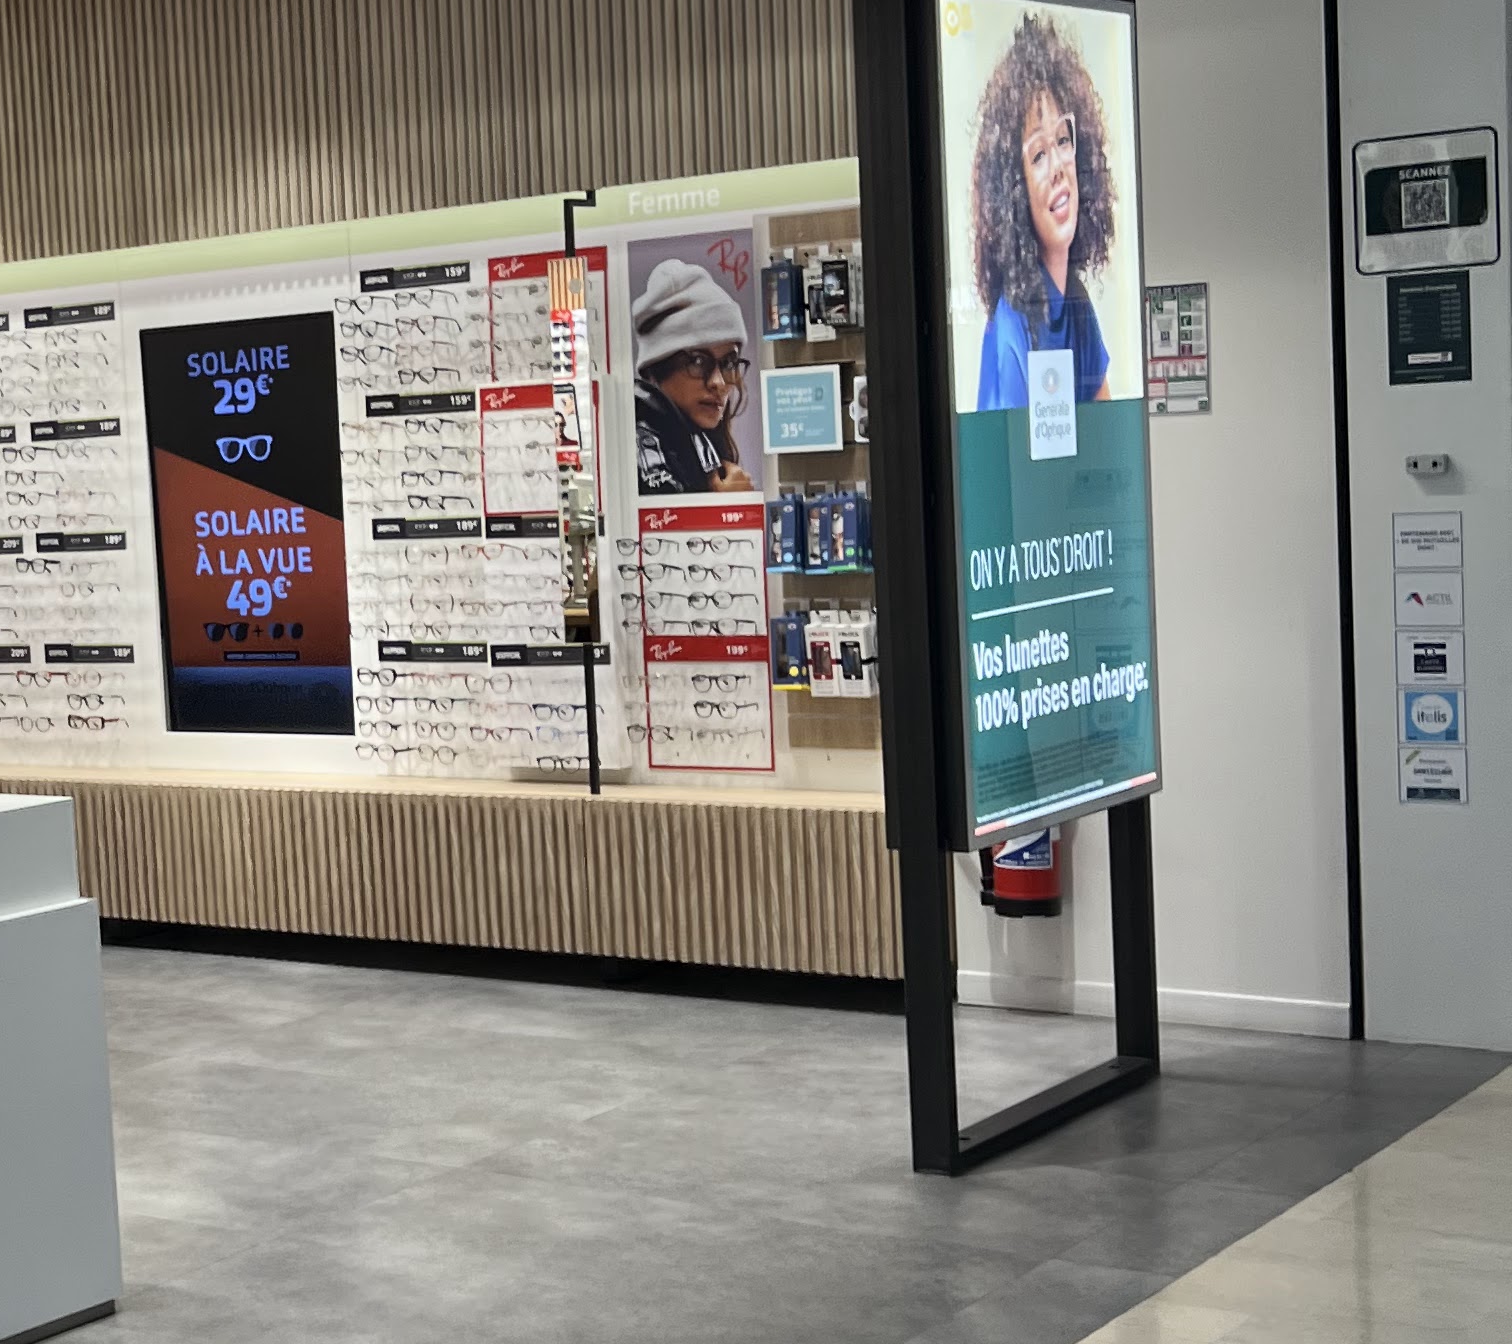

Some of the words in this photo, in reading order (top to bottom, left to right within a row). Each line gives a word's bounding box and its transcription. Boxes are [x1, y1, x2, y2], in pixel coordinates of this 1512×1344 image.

[628, 188, 721, 216] Femme
[187, 344, 291, 378] SOLAIRE
[194, 507, 307, 538] SOLAIRE
[195, 544, 214, 577] À
[220, 548, 253, 576] LA
[257, 547, 313, 574] VUE
[969, 546, 993, 592] ON
[994, 546, 1005, 586] Y
[1008, 543, 1021, 585] A
[1062, 530, 1104, 579] DROIT
[1106, 528, 1113, 565] !
[972, 639, 1004, 682] Vos
[1004, 629, 1070, 678] lunettes
[975, 690, 1019, 733] 100%
[1021, 681, 1069, 729] prises
[1071, 676, 1092, 703] en
